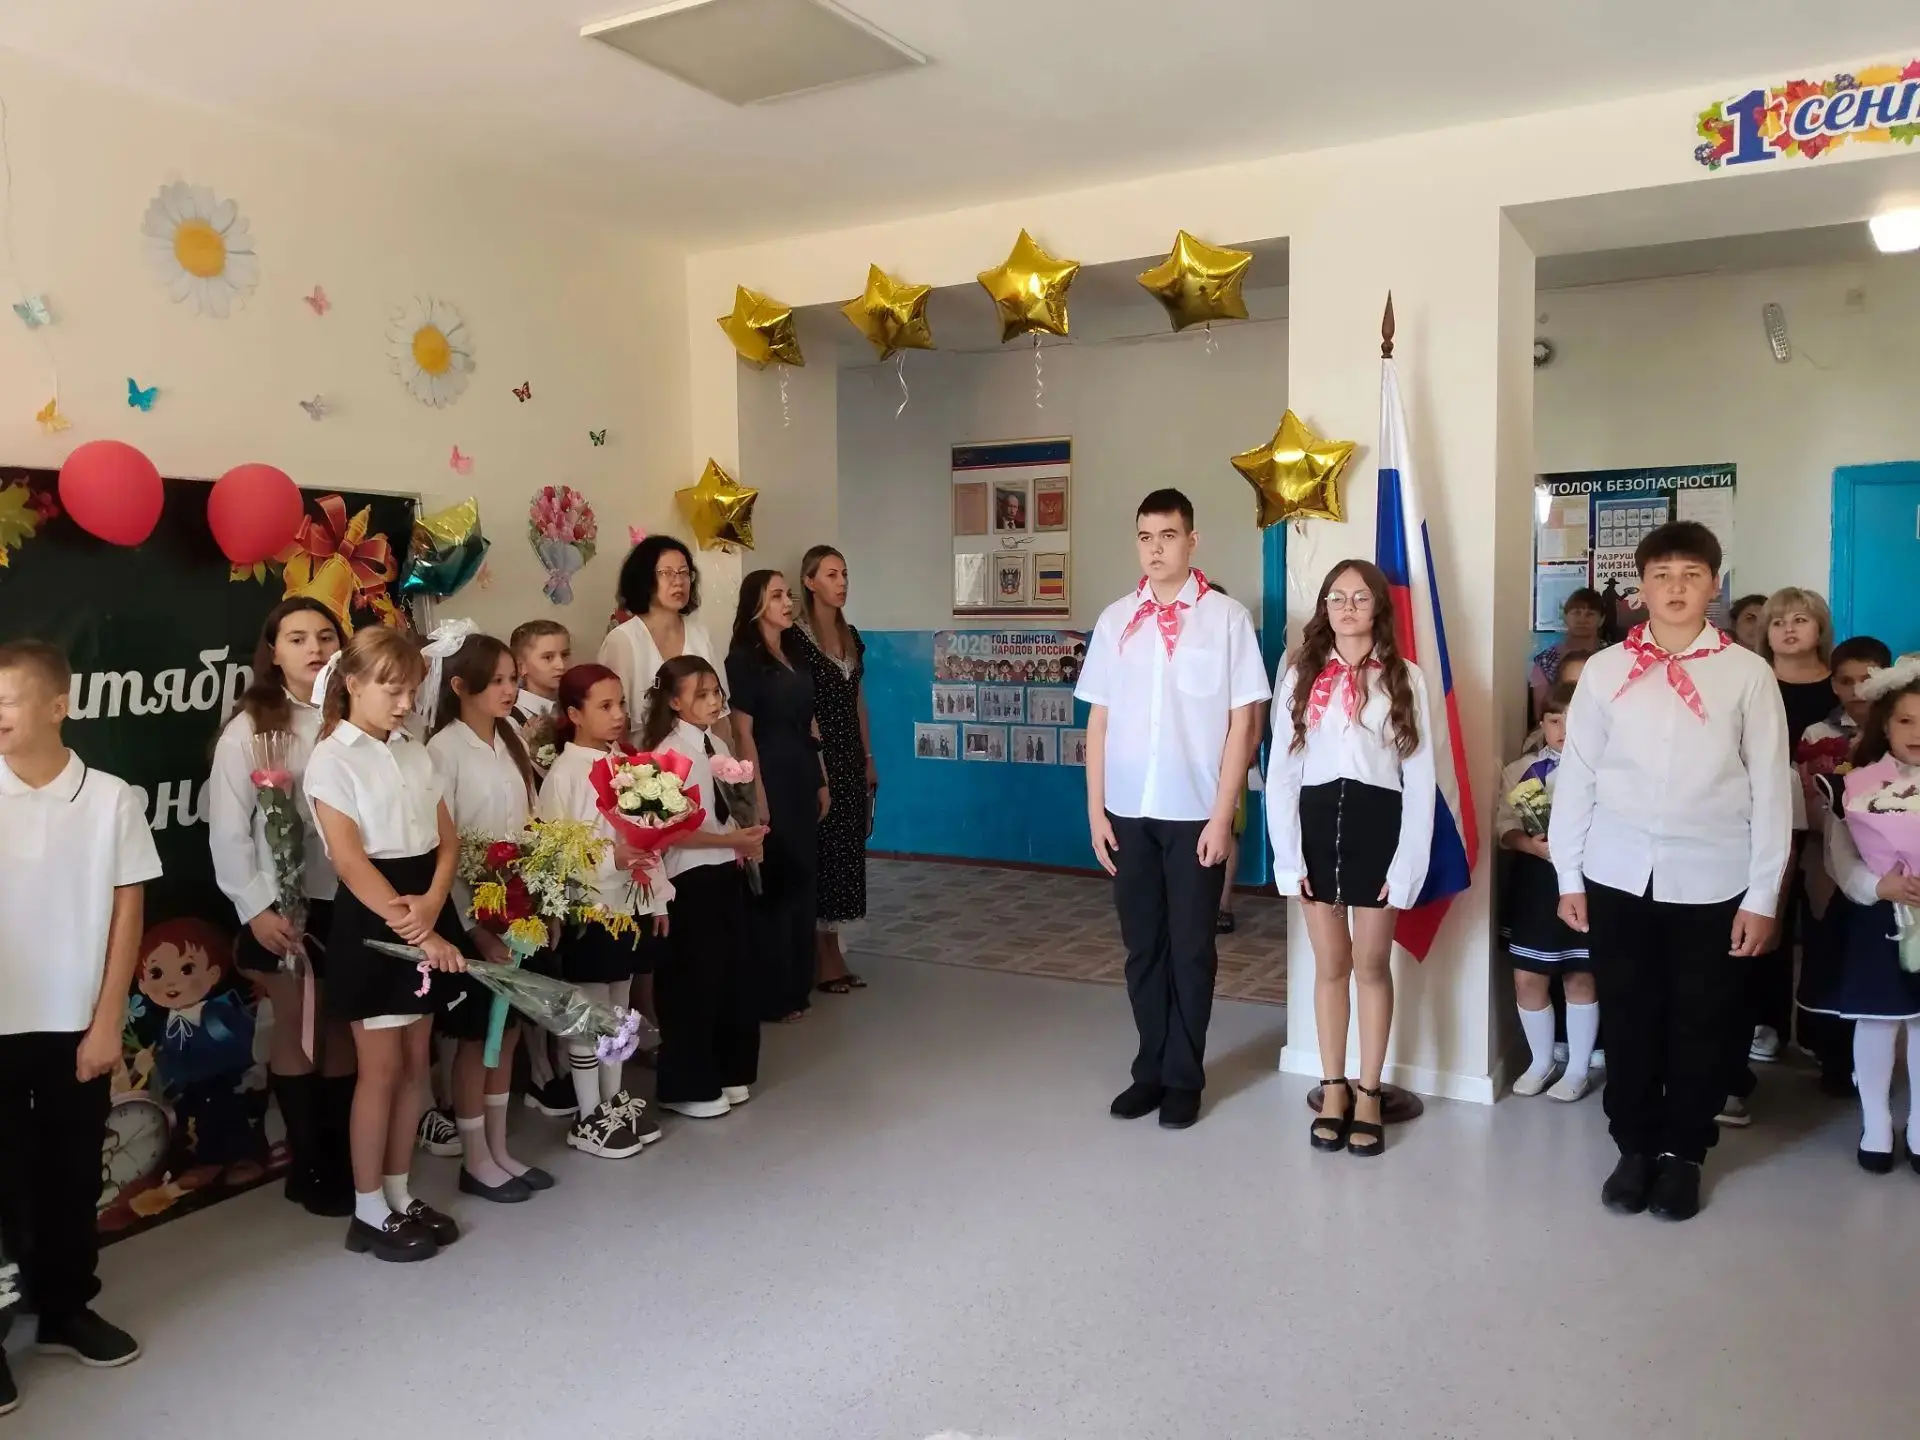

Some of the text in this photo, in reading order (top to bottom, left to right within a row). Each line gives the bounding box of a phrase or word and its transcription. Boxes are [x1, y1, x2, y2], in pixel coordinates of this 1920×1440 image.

[1726, 90, 1777, 166] 1
[1543, 474, 1732, 495] УГОЛОК БЕЗОПАСНОСТИ
[1597, 552, 1637, 560] РАЗРУШ
[947, 634, 1056, 655] 2026 ГОД ЕДИНСТВА
[992, 645, 1072, 655] НАРОДОВ РОССИИ
